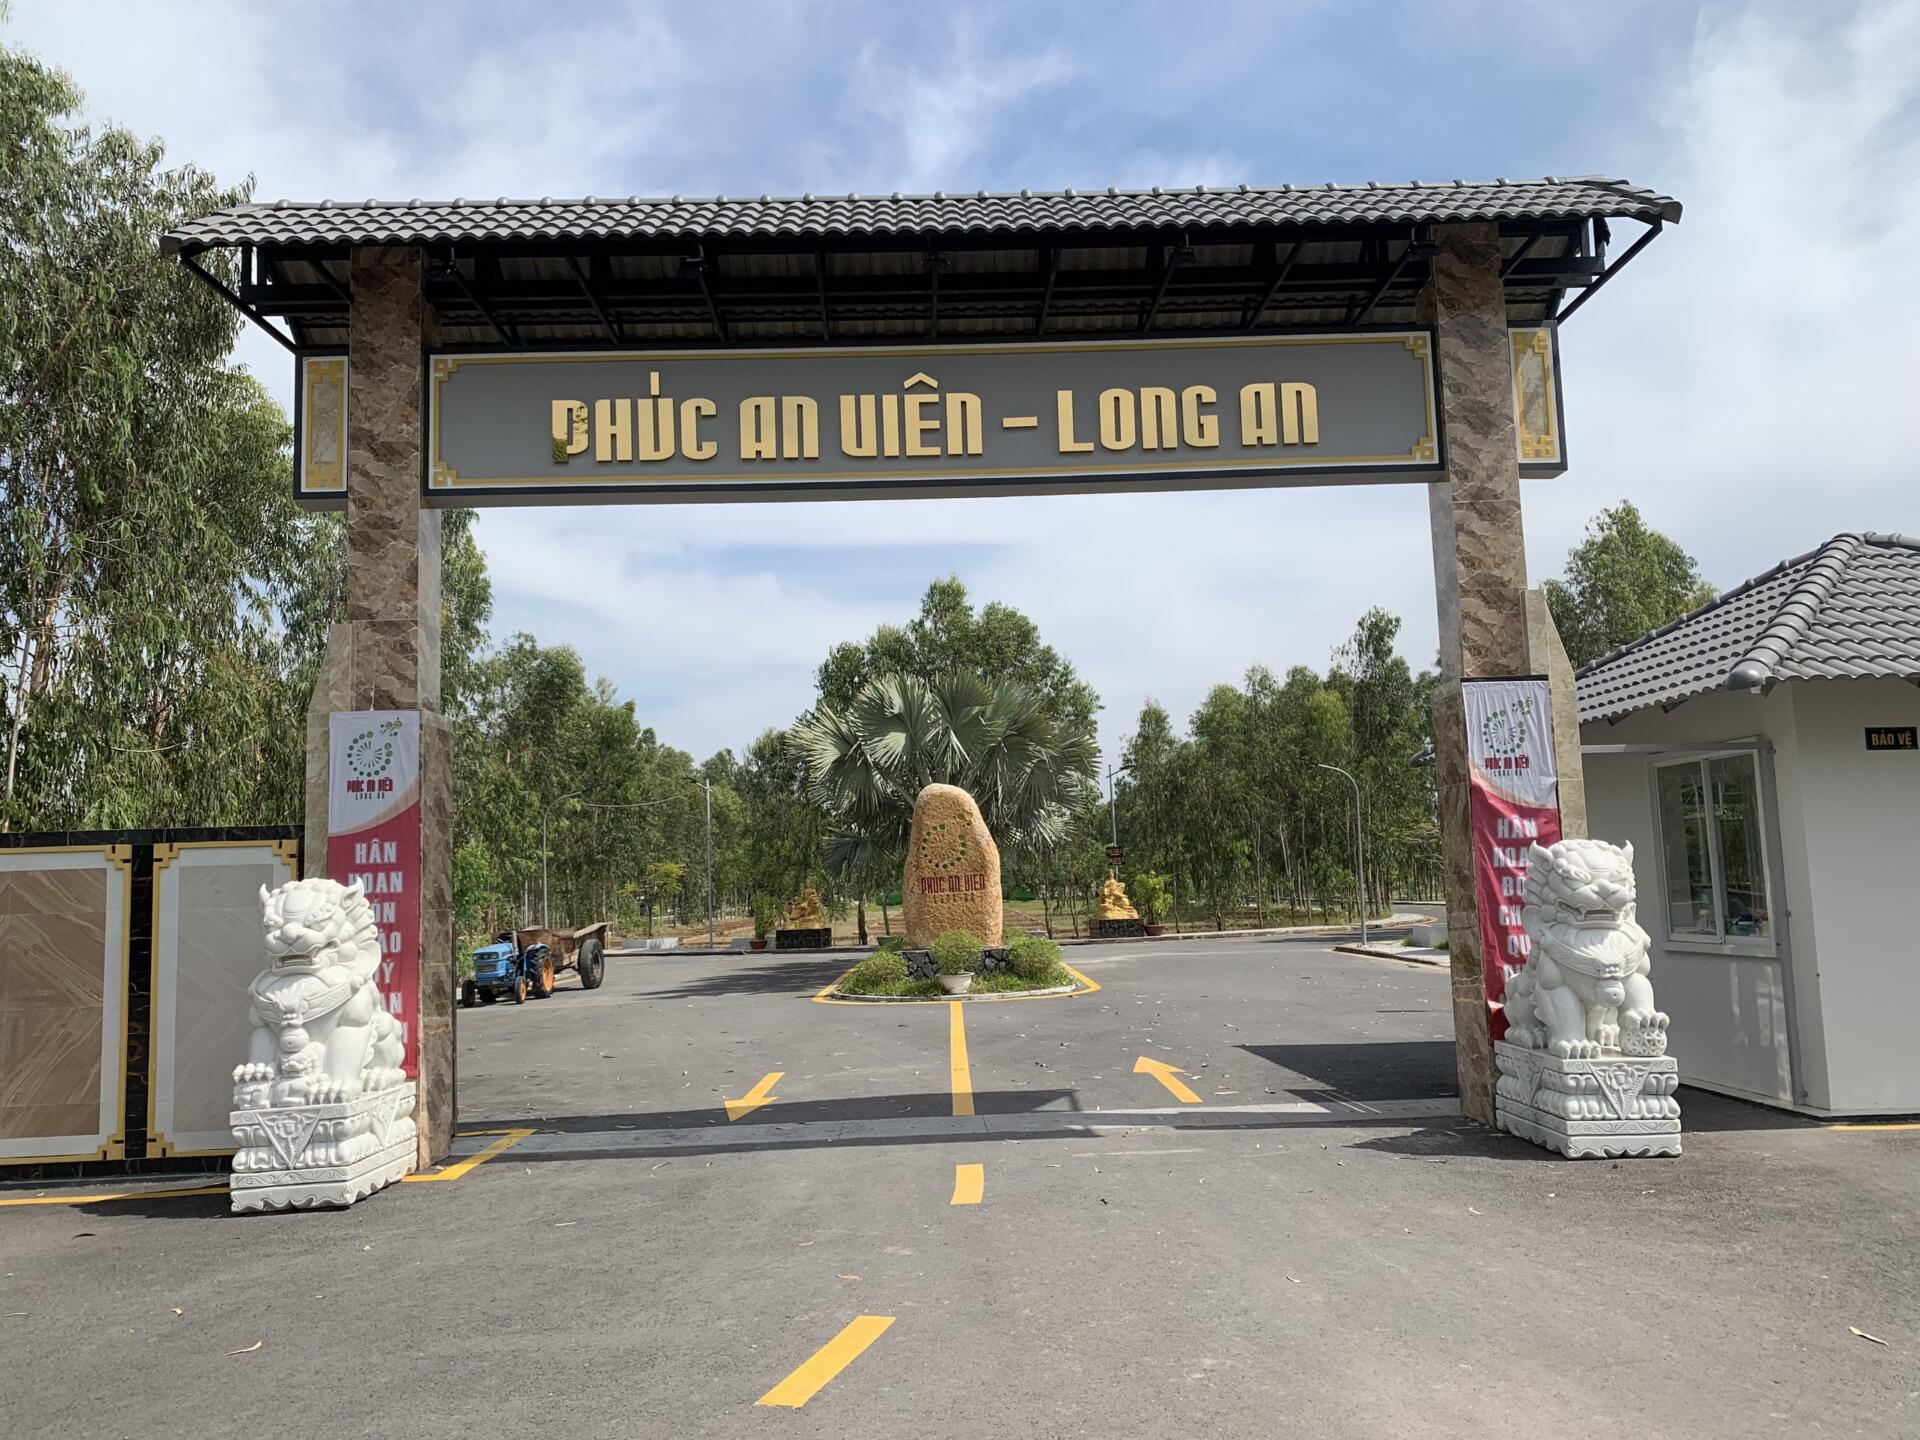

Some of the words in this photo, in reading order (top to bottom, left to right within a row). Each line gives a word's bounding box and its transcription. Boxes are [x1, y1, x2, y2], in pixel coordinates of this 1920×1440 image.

[552, 372, 718, 464] PHÚC
[740, 396, 820, 460] AN
[1057, 385, 1220, 453] LONG
[1240, 382, 1319, 447] AN
[1497, 815, 1538, 839] HÂN
[355, 839, 396, 864] HÂN
[1493, 847, 1530, 868] HOA
[1502, 869, 1527, 897] ĐÓ
[370, 896, 396, 923] ÓN
[1499, 905, 1522, 926] CH
[1508, 934, 1531, 958] QU
